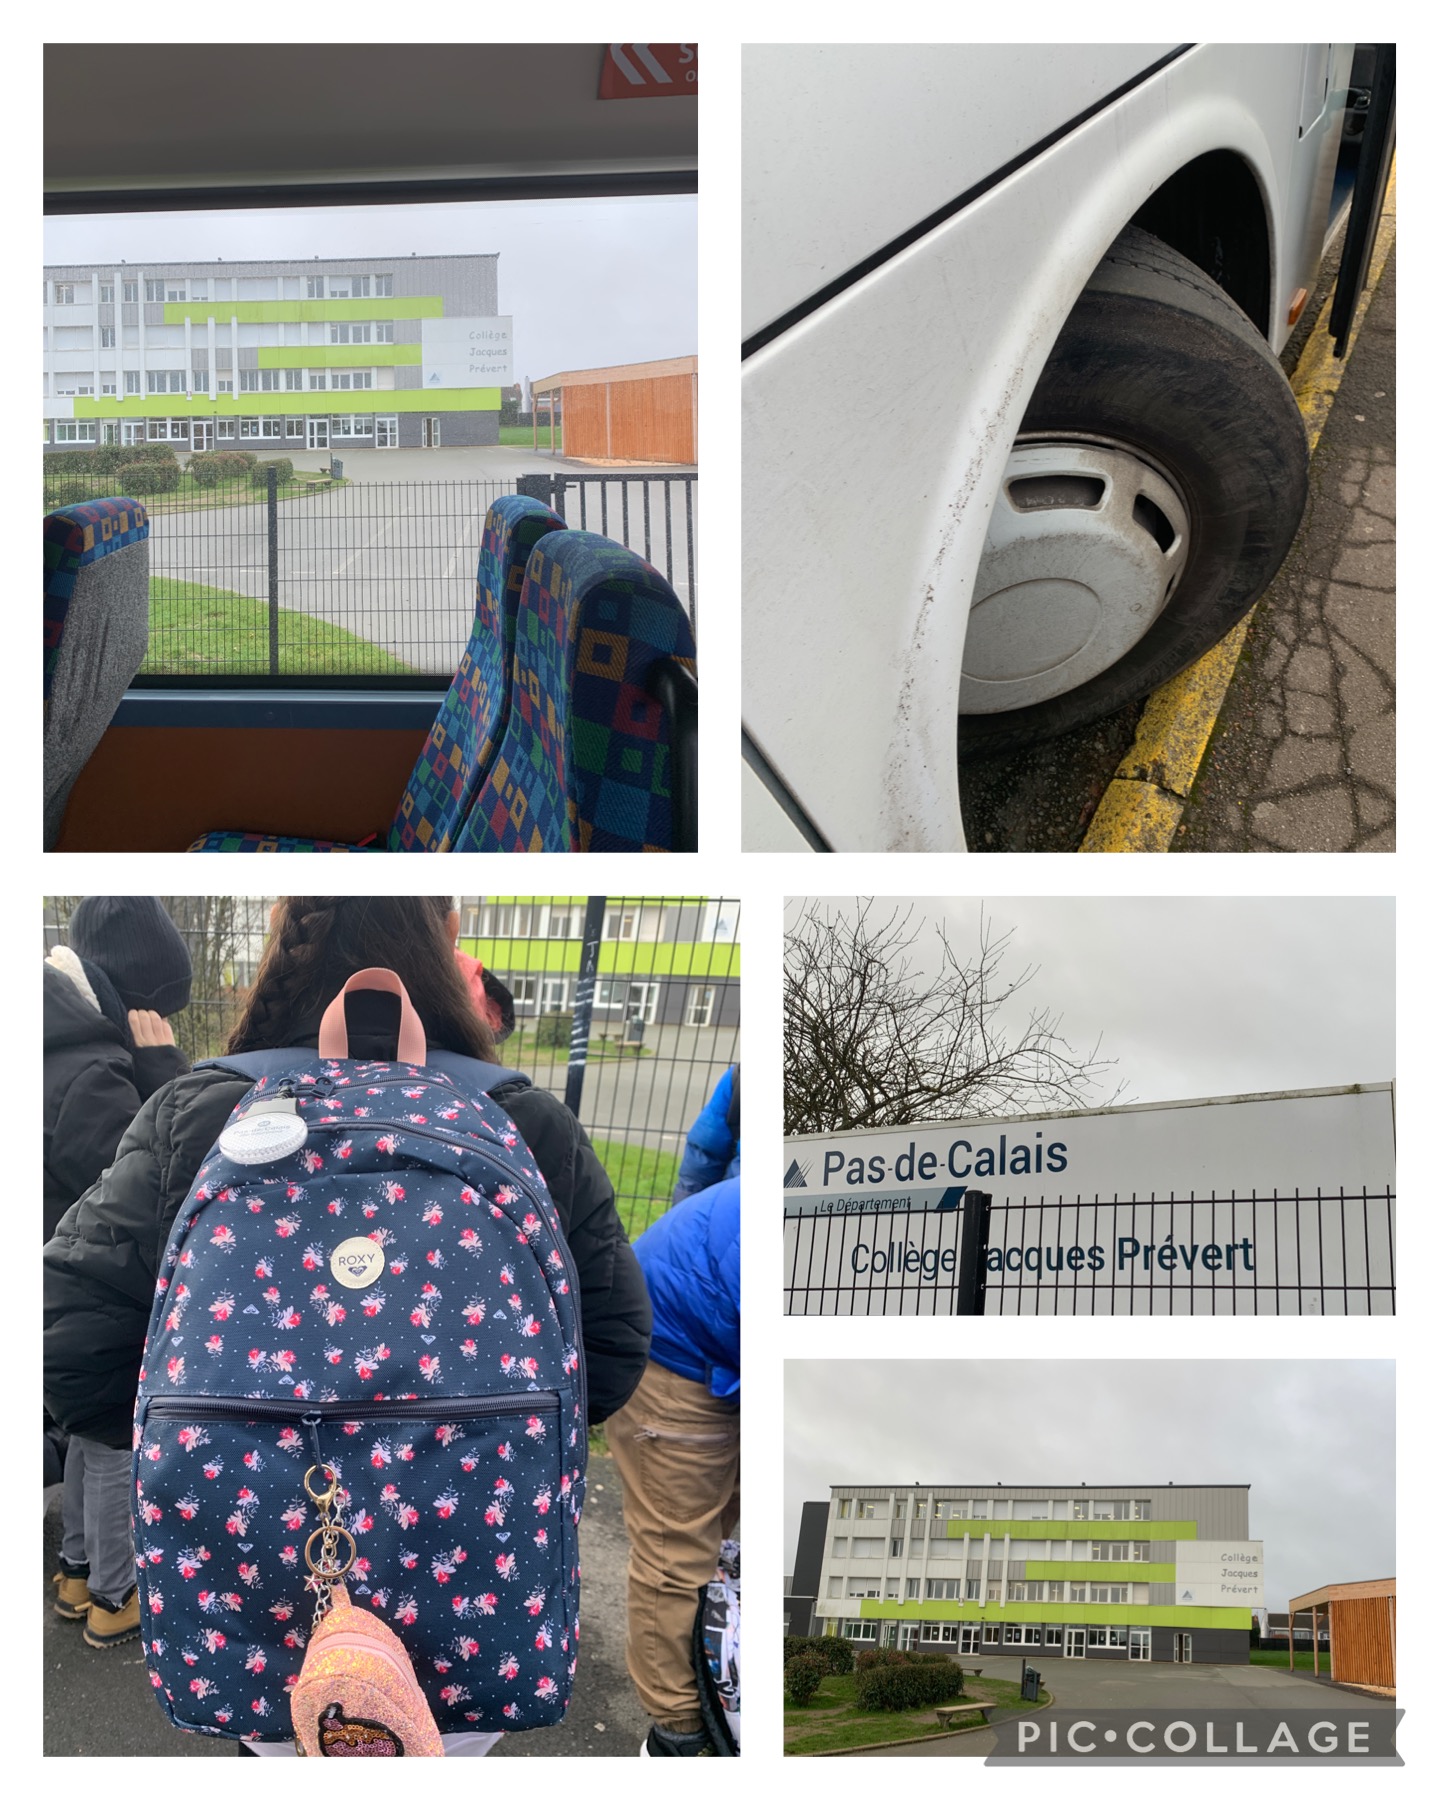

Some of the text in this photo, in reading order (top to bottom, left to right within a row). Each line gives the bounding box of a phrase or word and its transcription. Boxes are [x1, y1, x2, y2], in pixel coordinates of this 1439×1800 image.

[469, 330, 507, 341] Collège
[469, 347, 507, 357] Jacques
[469, 364, 507, 373] Prévert
[823, 1131, 1068, 1186] Pas-de-Calais
[820, 1196, 911, 1213] Le Département
[338, 1253, 375, 1266] ROXY
[851, 1234, 1254, 1281] Collège acques Prévert
[1221, 1553, 1259, 1564] Collège
[1221, 1568, 1259, 1579] Jacques
[1221, 1584, 1259, 1594] Prévert
